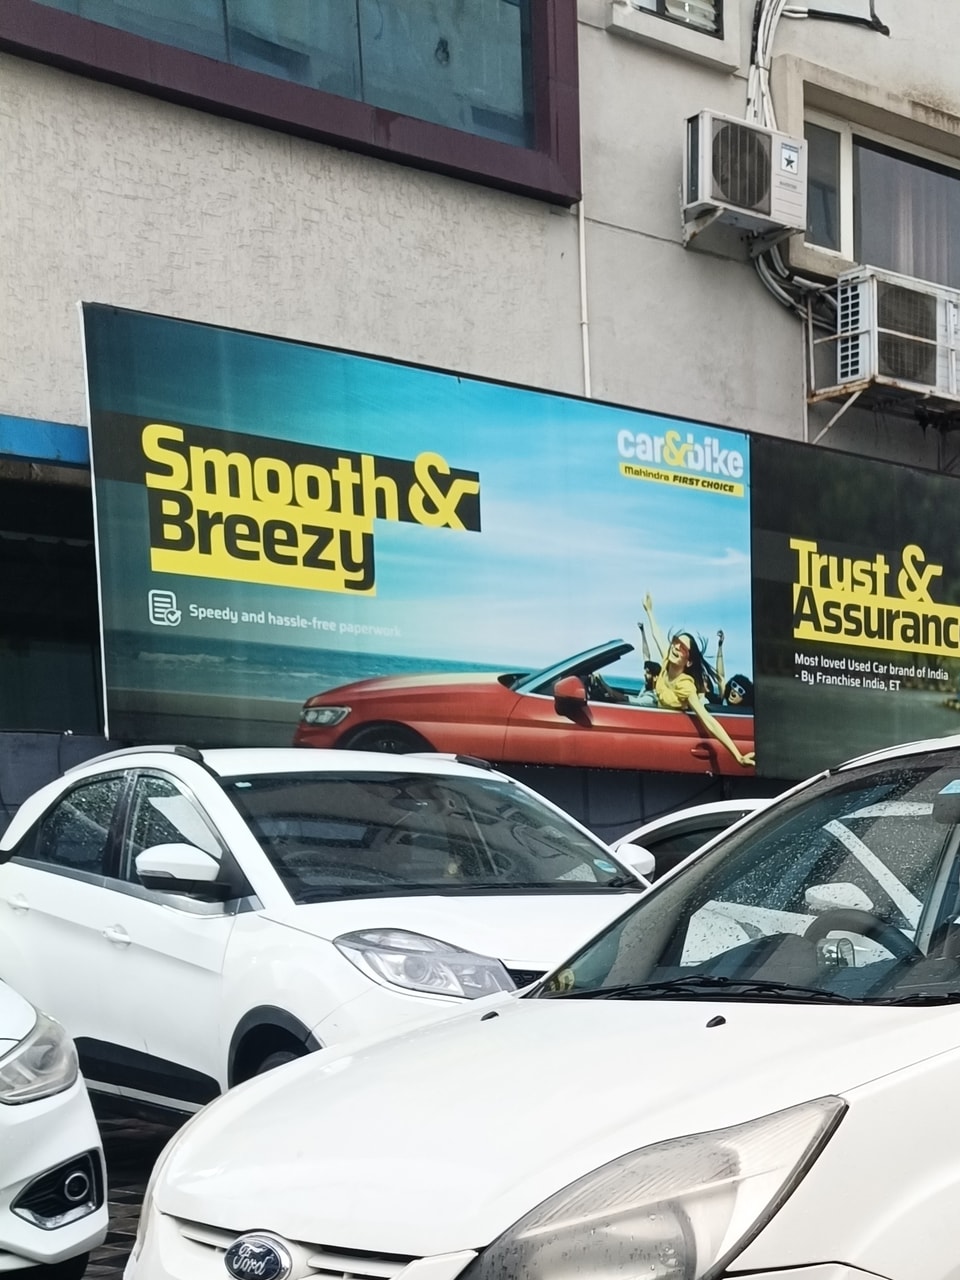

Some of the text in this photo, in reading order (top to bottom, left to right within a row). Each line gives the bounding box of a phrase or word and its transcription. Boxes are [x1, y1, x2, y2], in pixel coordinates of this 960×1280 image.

[617, 429, 744, 478] car&bike
[142, 424, 480, 531] Smooth &
[625, 466, 735, 493] Mahindra FIRST CHOICE
[148, 488, 375, 591] Breezy
[789, 537, 943, 604] Trust &
[189, 604, 402, 637] Speedy and hassle-free paperwork
[794, 652, 949, 681] Most loved Used Car brand of India
[801, 670, 815, 685] By
[816, 672, 861, 688] Franchise
[862, 677, 888, 691] India,
[889, 680, 901, 691] ET
[232, 1242, 275, 1276] Ford
